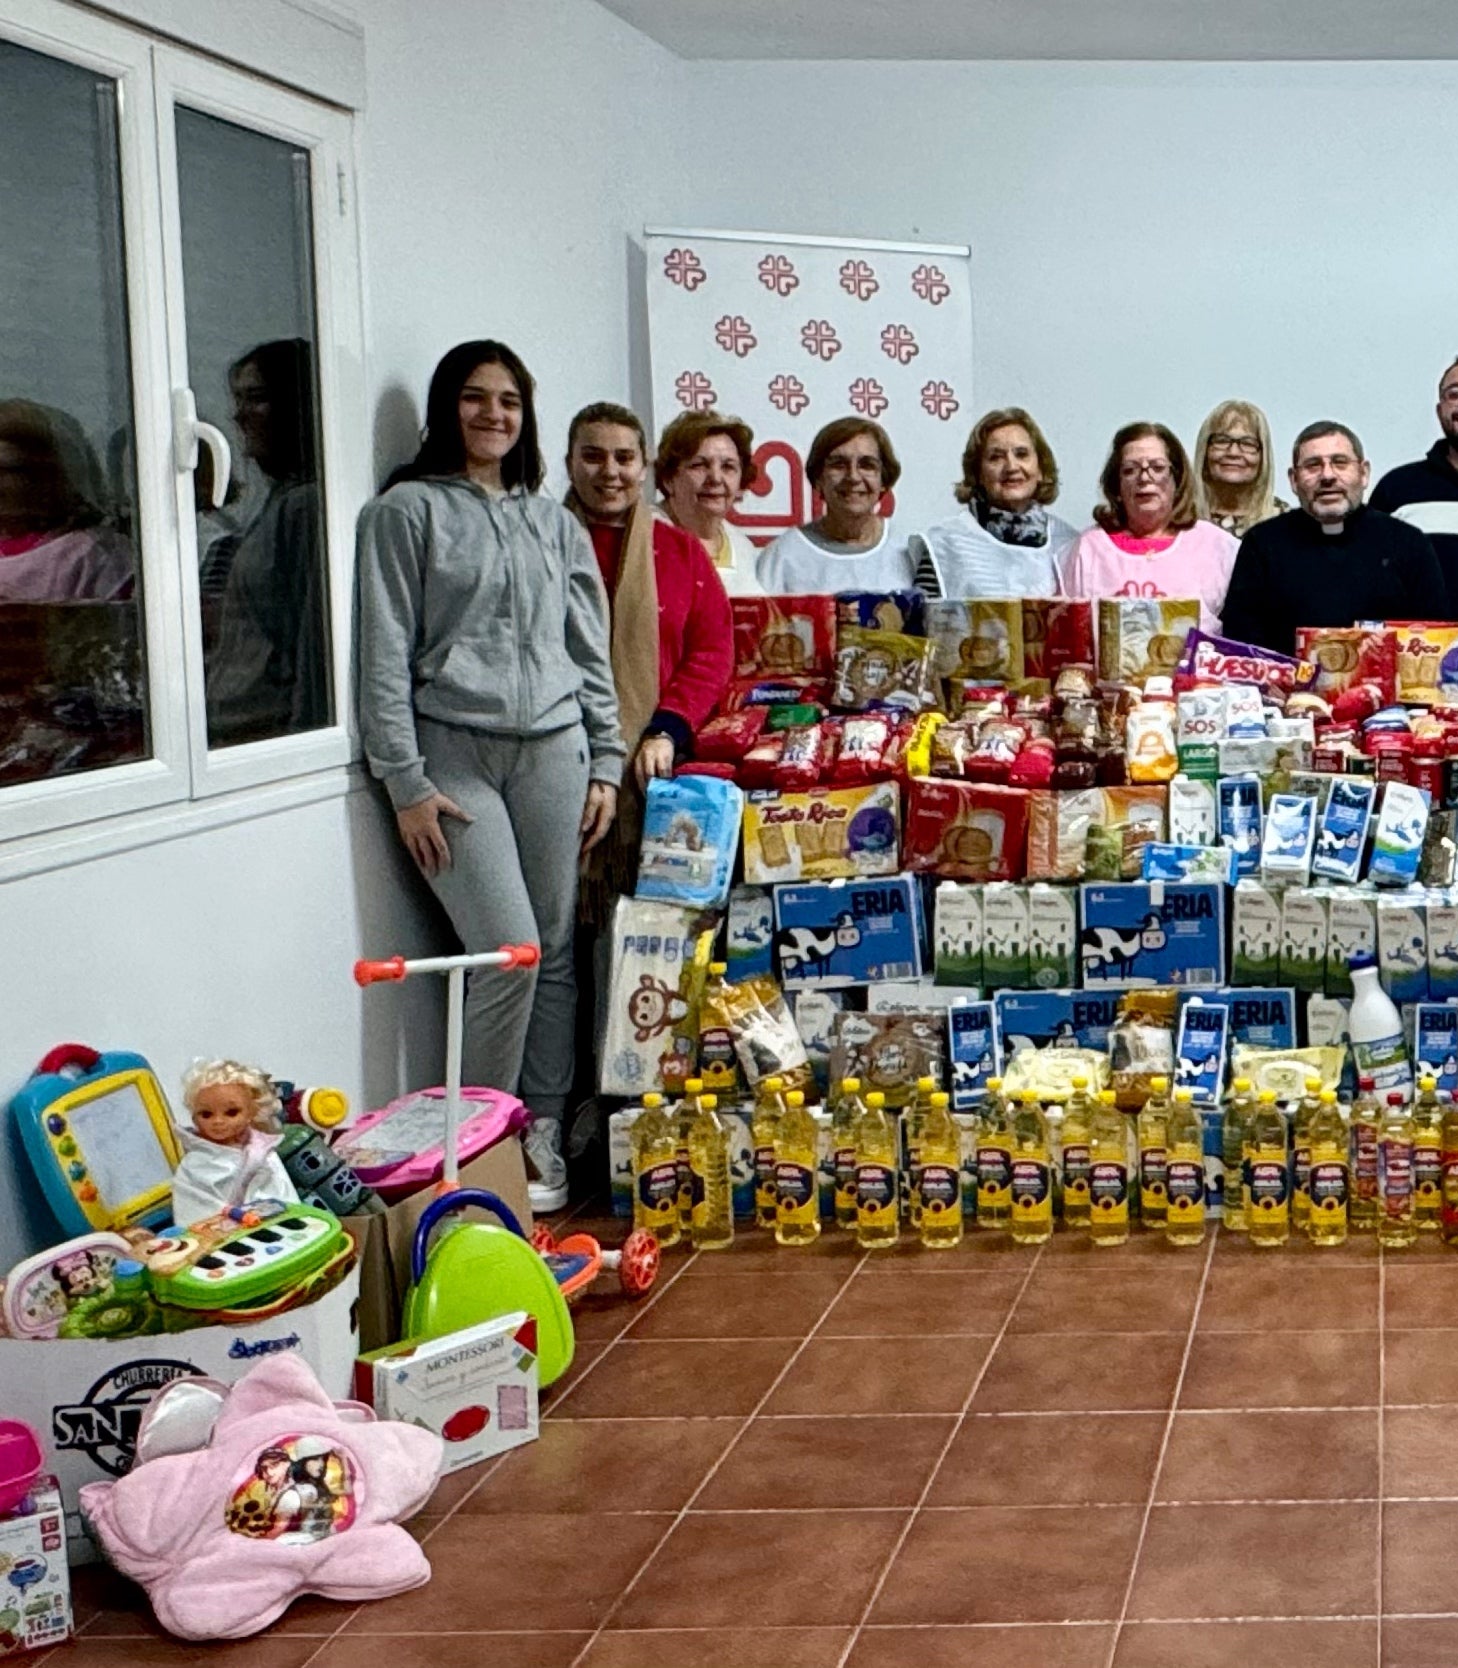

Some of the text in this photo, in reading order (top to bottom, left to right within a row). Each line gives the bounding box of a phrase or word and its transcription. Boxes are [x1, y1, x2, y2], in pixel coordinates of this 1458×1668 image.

[1184, 719, 1217, 735] SOS
[852, 888, 906, 916] ERIA
[1164, 893, 1214, 919] ERIA
[953, 1009, 992, 1032] ERIA
[1186, 1011, 1223, 1031] ERIA
[1234, 1000, 1287, 1026] ERIA
[1420, 1011, 1457, 1032] ERIA
[426, 1338, 505, 1373] MONTESSORI
